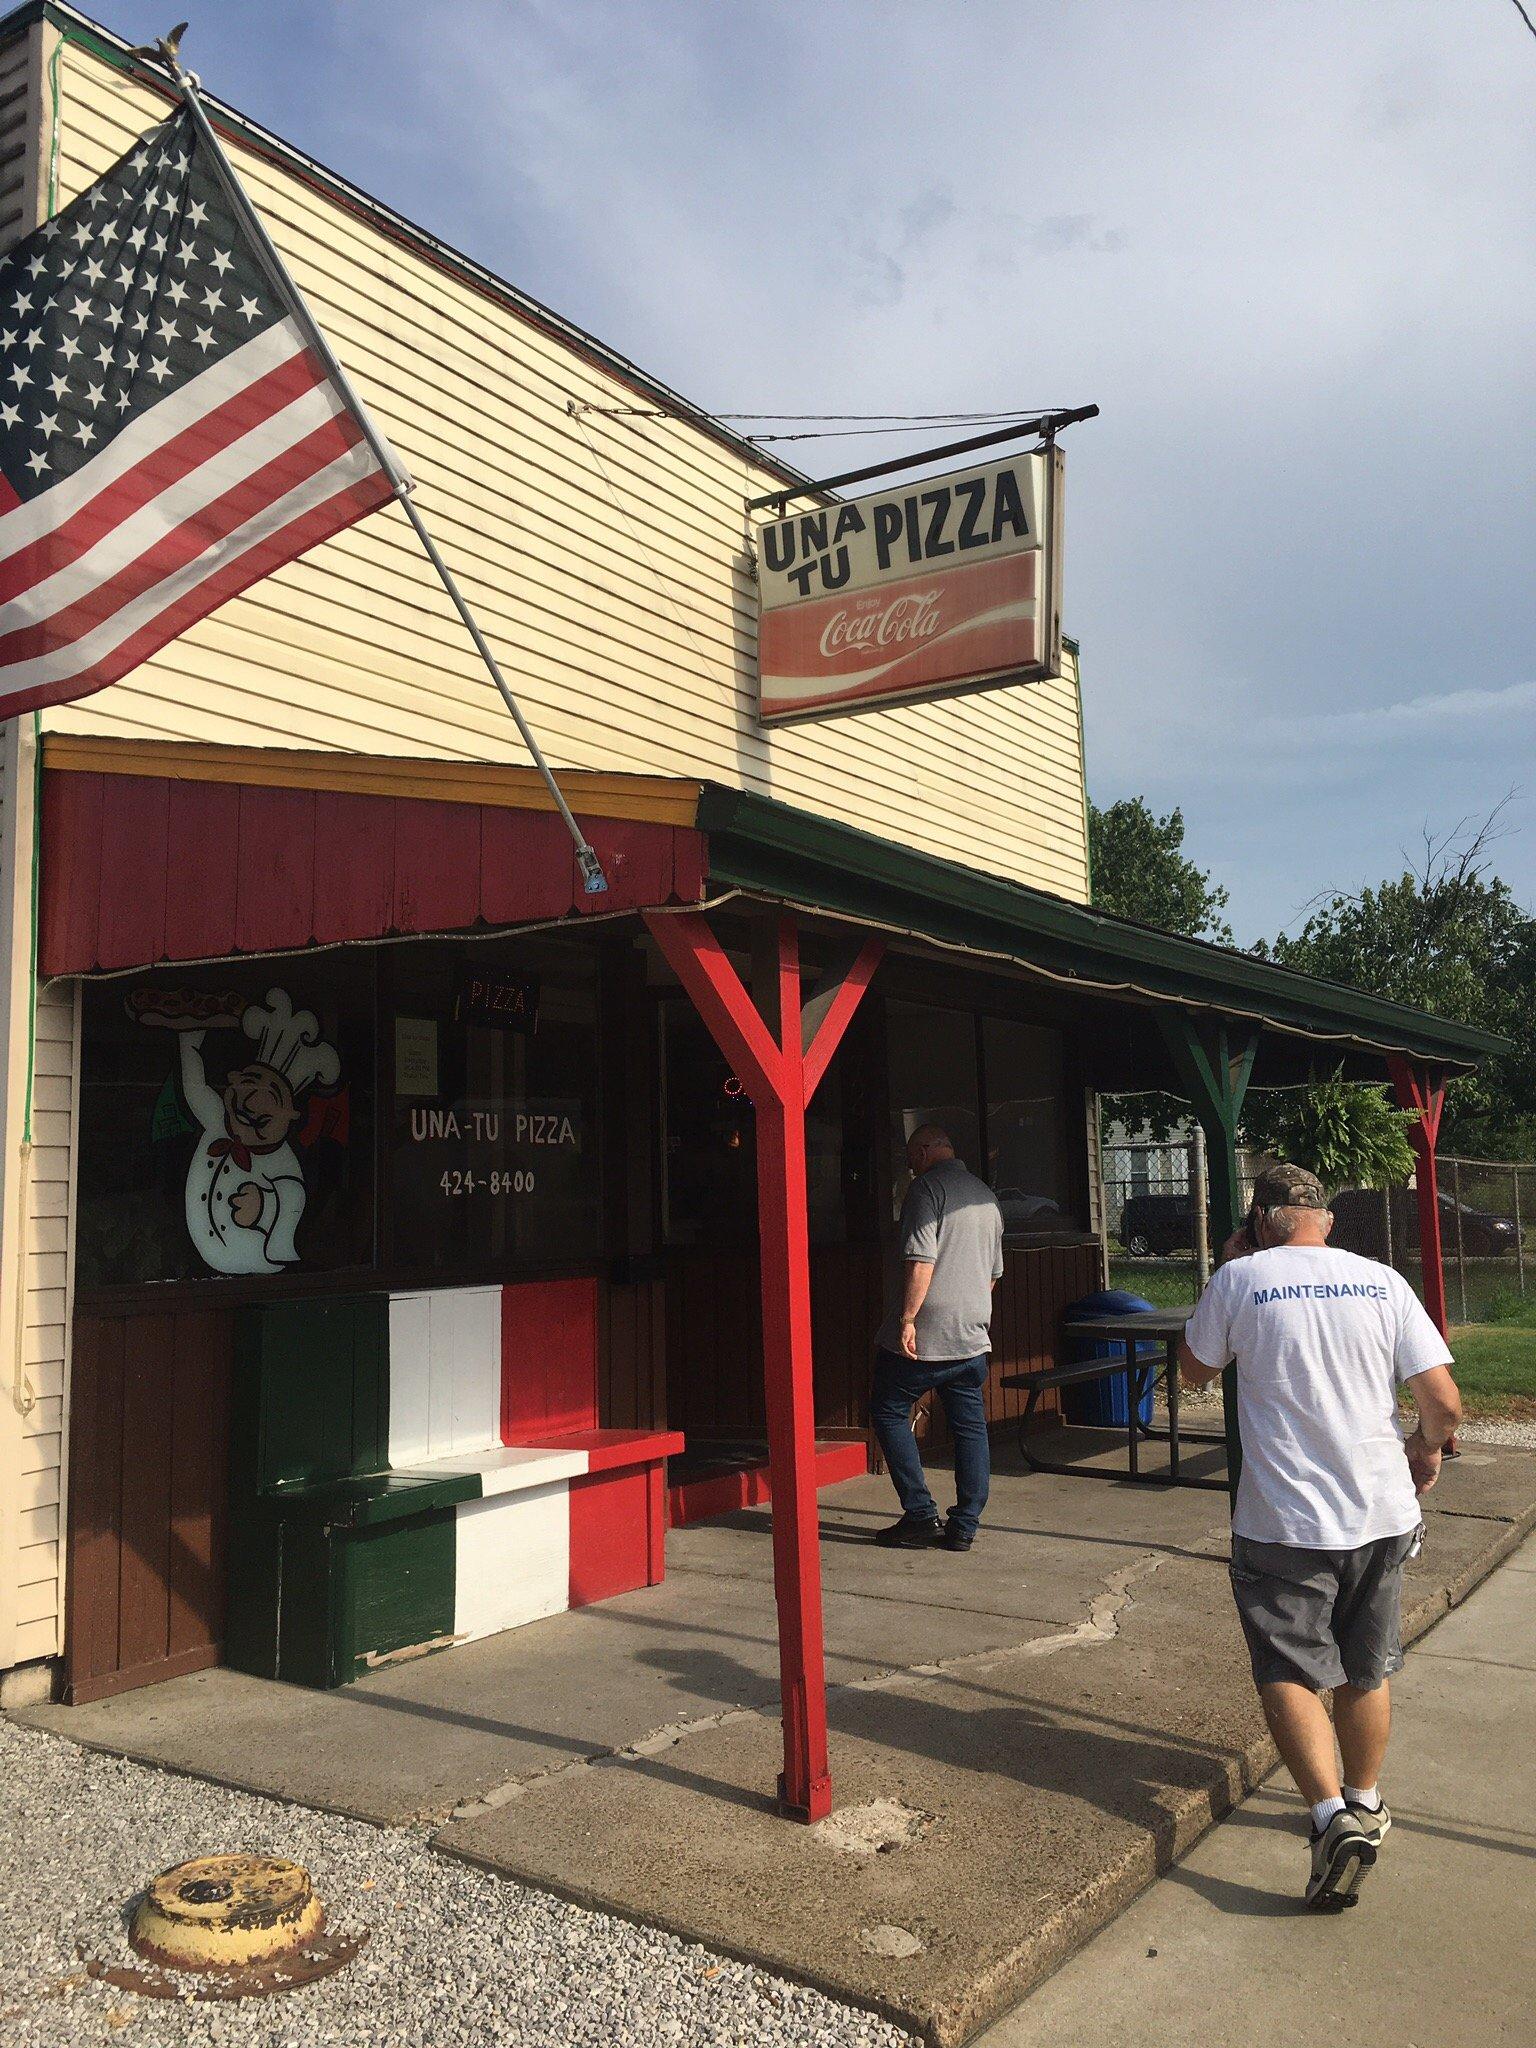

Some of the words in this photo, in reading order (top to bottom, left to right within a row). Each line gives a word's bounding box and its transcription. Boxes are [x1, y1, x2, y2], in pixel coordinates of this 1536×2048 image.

[763, 504, 866, 572] UNA
[874, 470, 1029, 570] PIZZA
[788, 545, 850, 596] TU
[471, 979, 525, 1014] PIZZA
[411, 1108, 499, 1142] UNA-TU
[516, 1113, 576, 1144] PIZZA
[439, 1169, 535, 1196] 424-8400
[1254, 1284, 1387, 1305] MAINTENANCE
